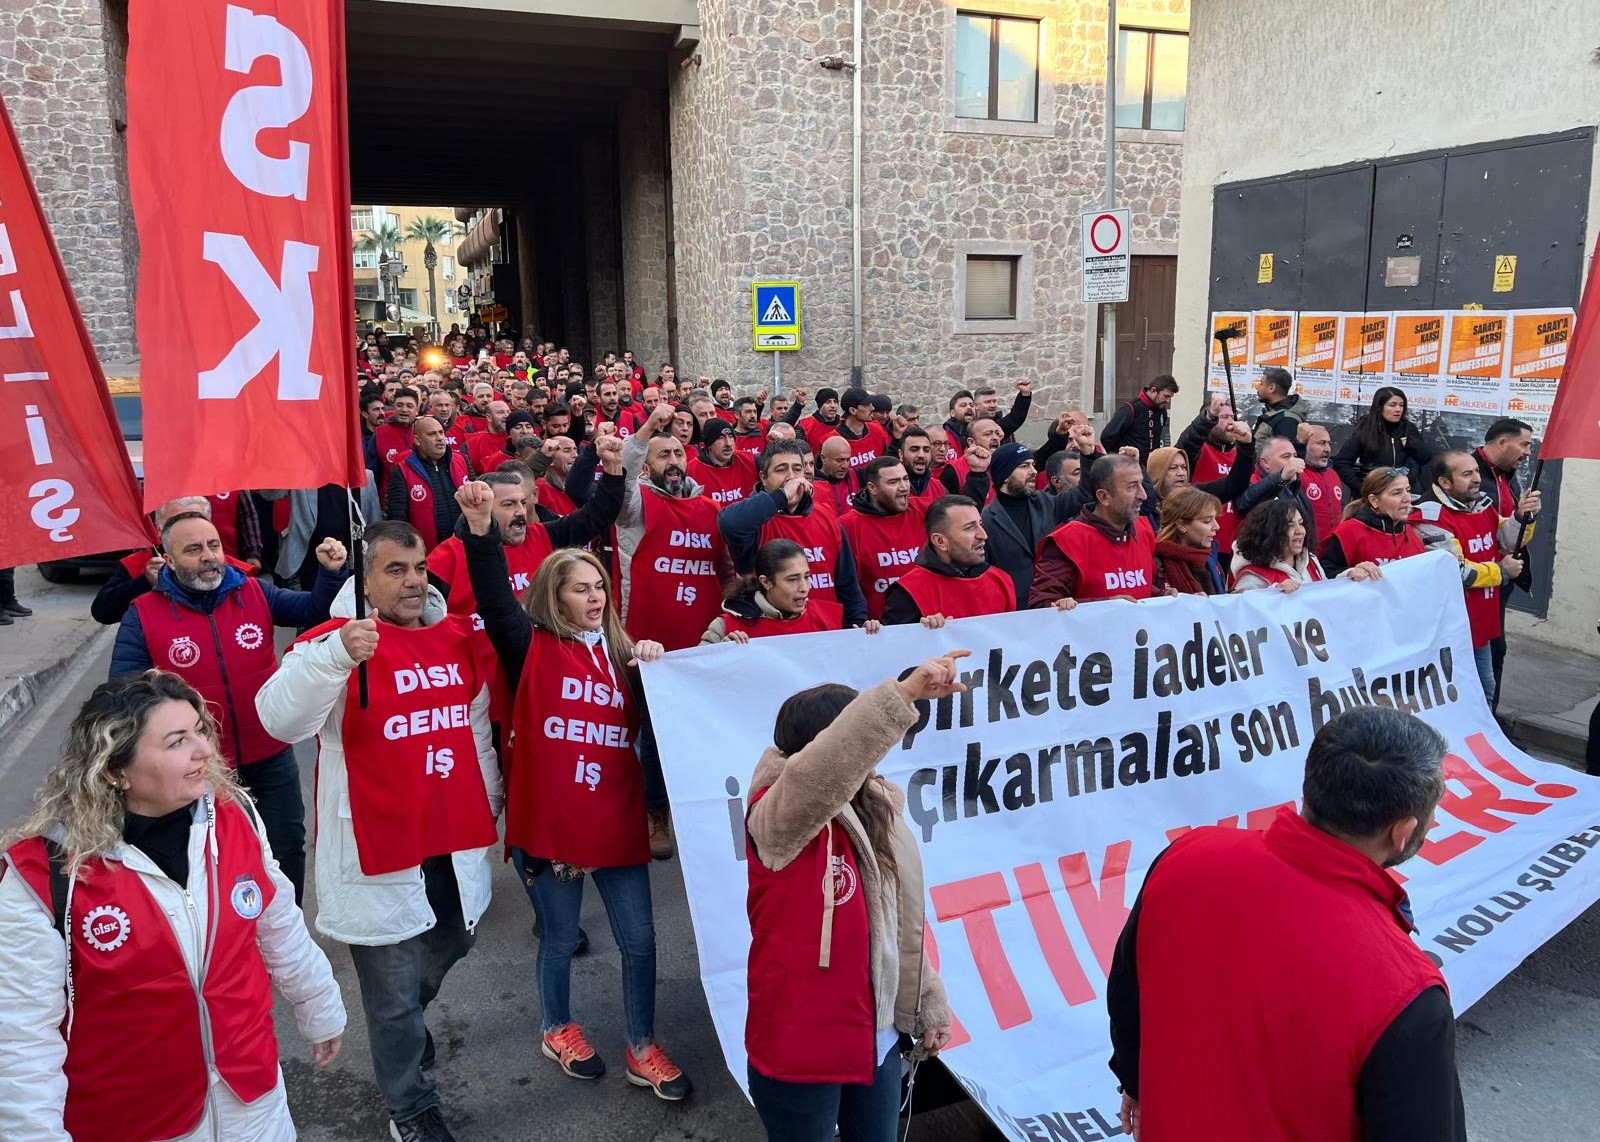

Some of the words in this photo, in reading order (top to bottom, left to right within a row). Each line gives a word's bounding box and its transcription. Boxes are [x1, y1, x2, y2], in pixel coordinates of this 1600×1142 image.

[1415, 319, 1440, 334] SARAY'A
[1472, 320, 1502, 336] SARAY'A
[1537, 318, 1568, 335] SARAY'A
[1480, 331, 1502, 345] KARŞI
[1544, 330, 1568, 346] KARŞI
[850, 450, 876, 466] DİSK
[711, 486, 743, 502] DİSK
[669, 528, 712, 549] DİSK
[806, 546, 826, 562] SK
[654, 556, 716, 576] GENEL
[1104, 566, 1148, 590] DİSK
[676, 582, 696, 606] İŞ
[1133, 620, 1268, 700] iadeler
[1280, 618, 1330, 667] ve
[394, 662, 464, 695] DİSK
[561, 674, 624, 710] DİSK
[384, 704, 470, 741] GENEL
[543, 716, 630, 748] GENEL
[425, 745, 454, 779] İŞ
[574, 754, 602, 792] İŞ
[907, 710, 1222, 843] çıkarmalar
[1230, 701, 1300, 763] son
[1432, 890, 1532, 954] NOLU
[1516, 826, 1600, 892] ŞUBE
[93, 921, 119, 936] DİSK
